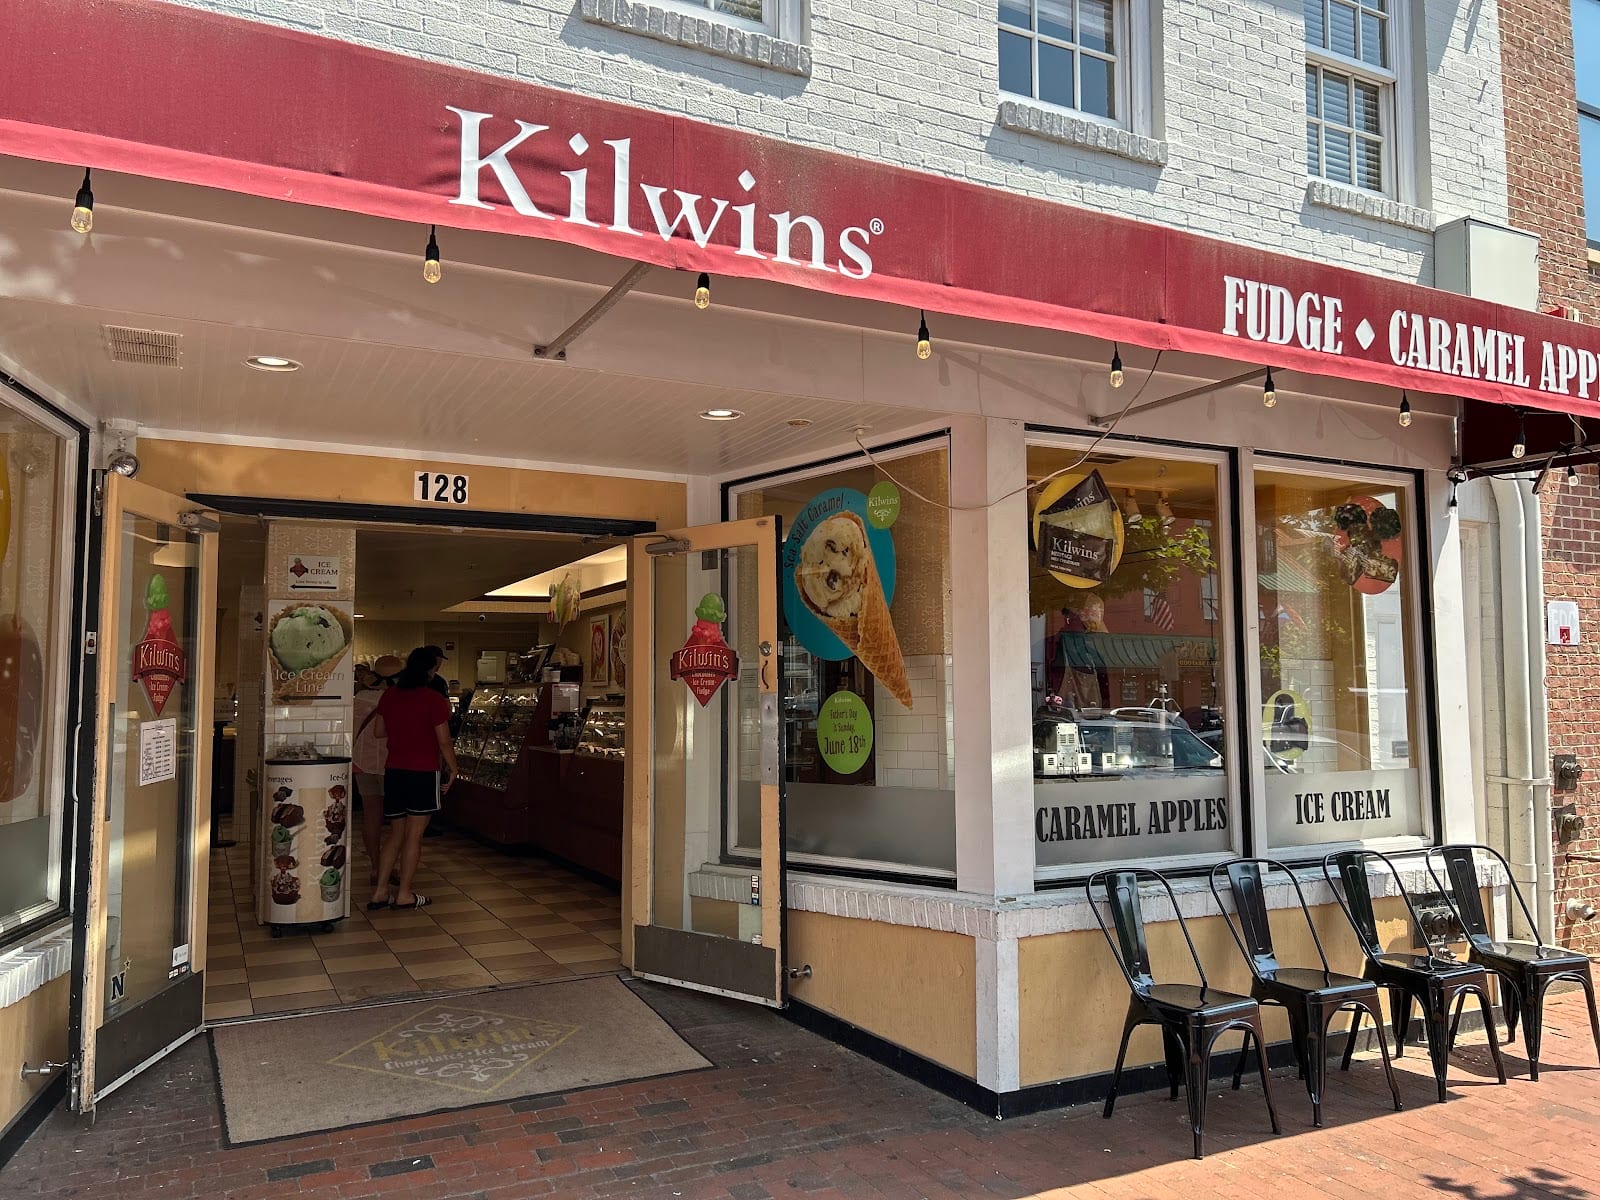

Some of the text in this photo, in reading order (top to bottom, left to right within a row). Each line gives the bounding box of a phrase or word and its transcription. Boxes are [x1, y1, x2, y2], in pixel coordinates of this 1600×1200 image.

[1222, 275, 1600, 401] FUDGE CARAMEL APP
[418, 472, 467, 504] 128
[807, 492, 844, 522] Caramel
[868, 496, 899, 508] Kilwins
[1052, 537, 1100, 560] Kilwins
[310, 568, 338, 576] CREAM
[140, 643, 180, 672] Kilwin's
[679, 648, 729, 670] Kilwin's
[276, 669, 345, 681] Ice Cream
[295, 681, 325, 693] Line
[824, 735, 866, 755] June 18th
[1295, 788, 1392, 825] ICE CREAM
[1034, 797, 1228, 843] CARAMEL APPLES
